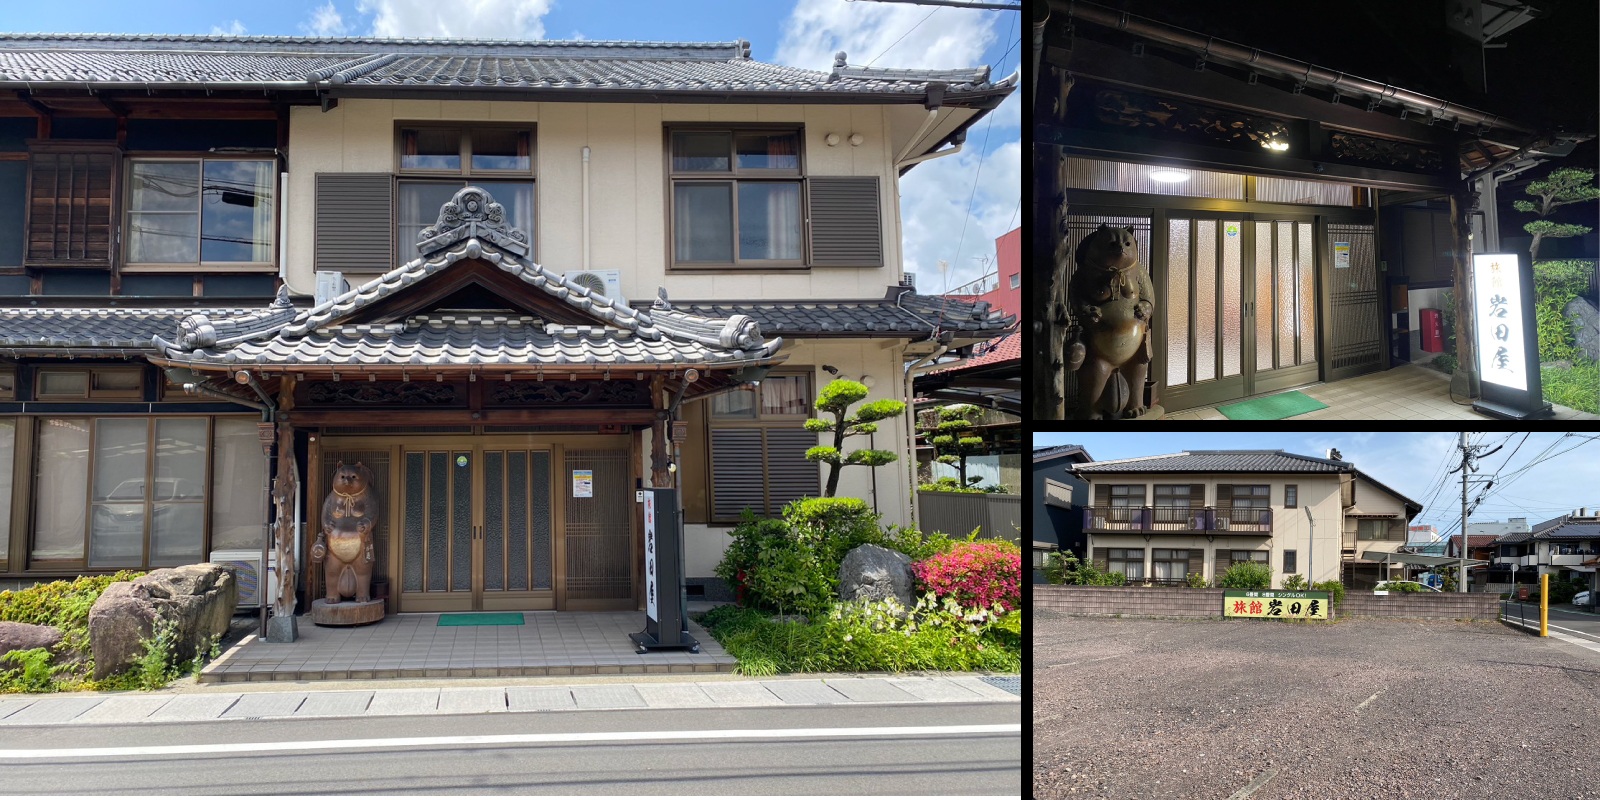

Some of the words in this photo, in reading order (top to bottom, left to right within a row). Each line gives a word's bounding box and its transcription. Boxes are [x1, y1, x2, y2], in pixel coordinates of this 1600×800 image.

[1489, 294, 1514, 373] 岩田屋
[647, 530, 655, 607] 岩田屋
[1233, 600, 1264, 615] 旅館
[1267, 599, 1322, 617] 岩田屋
